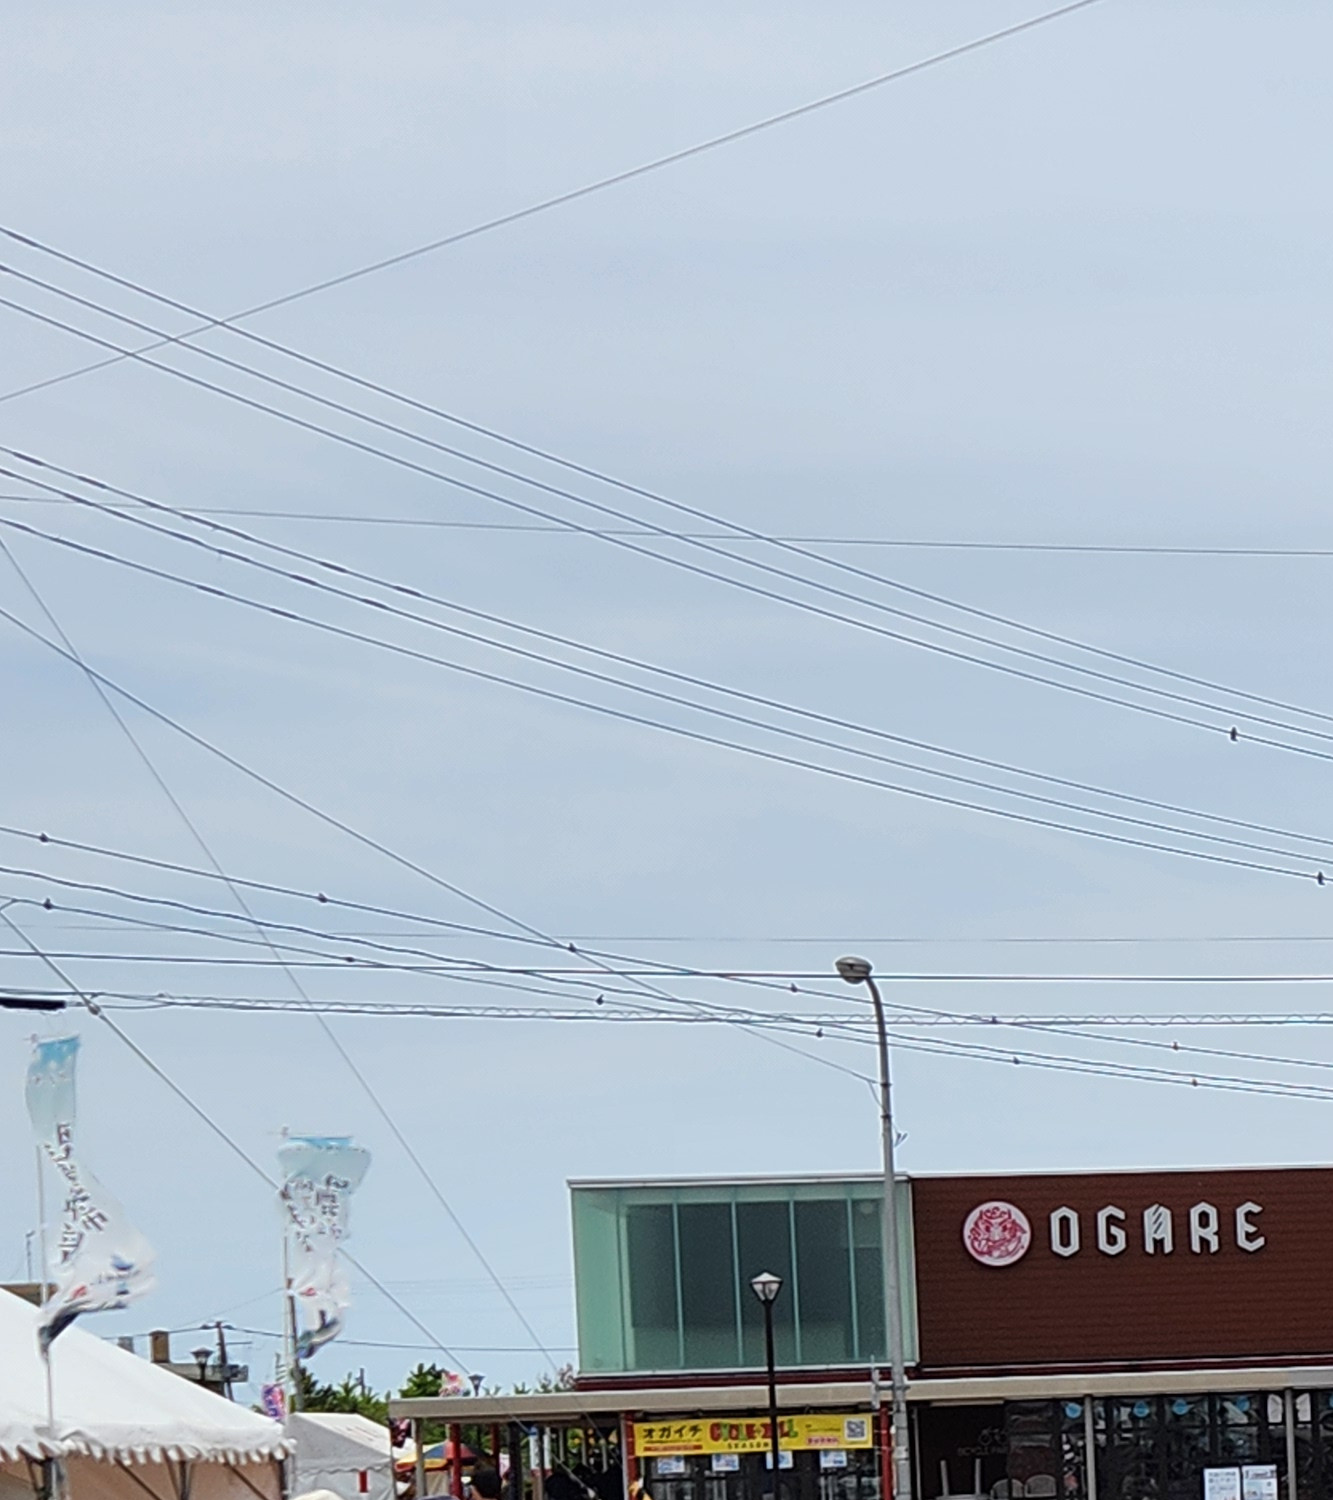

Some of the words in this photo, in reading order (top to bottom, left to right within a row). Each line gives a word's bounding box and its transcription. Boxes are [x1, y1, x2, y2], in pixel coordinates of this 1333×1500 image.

[1050, 1201, 1267, 1257] OGARE
[643, 1424, 702, 1439] オガイチ
